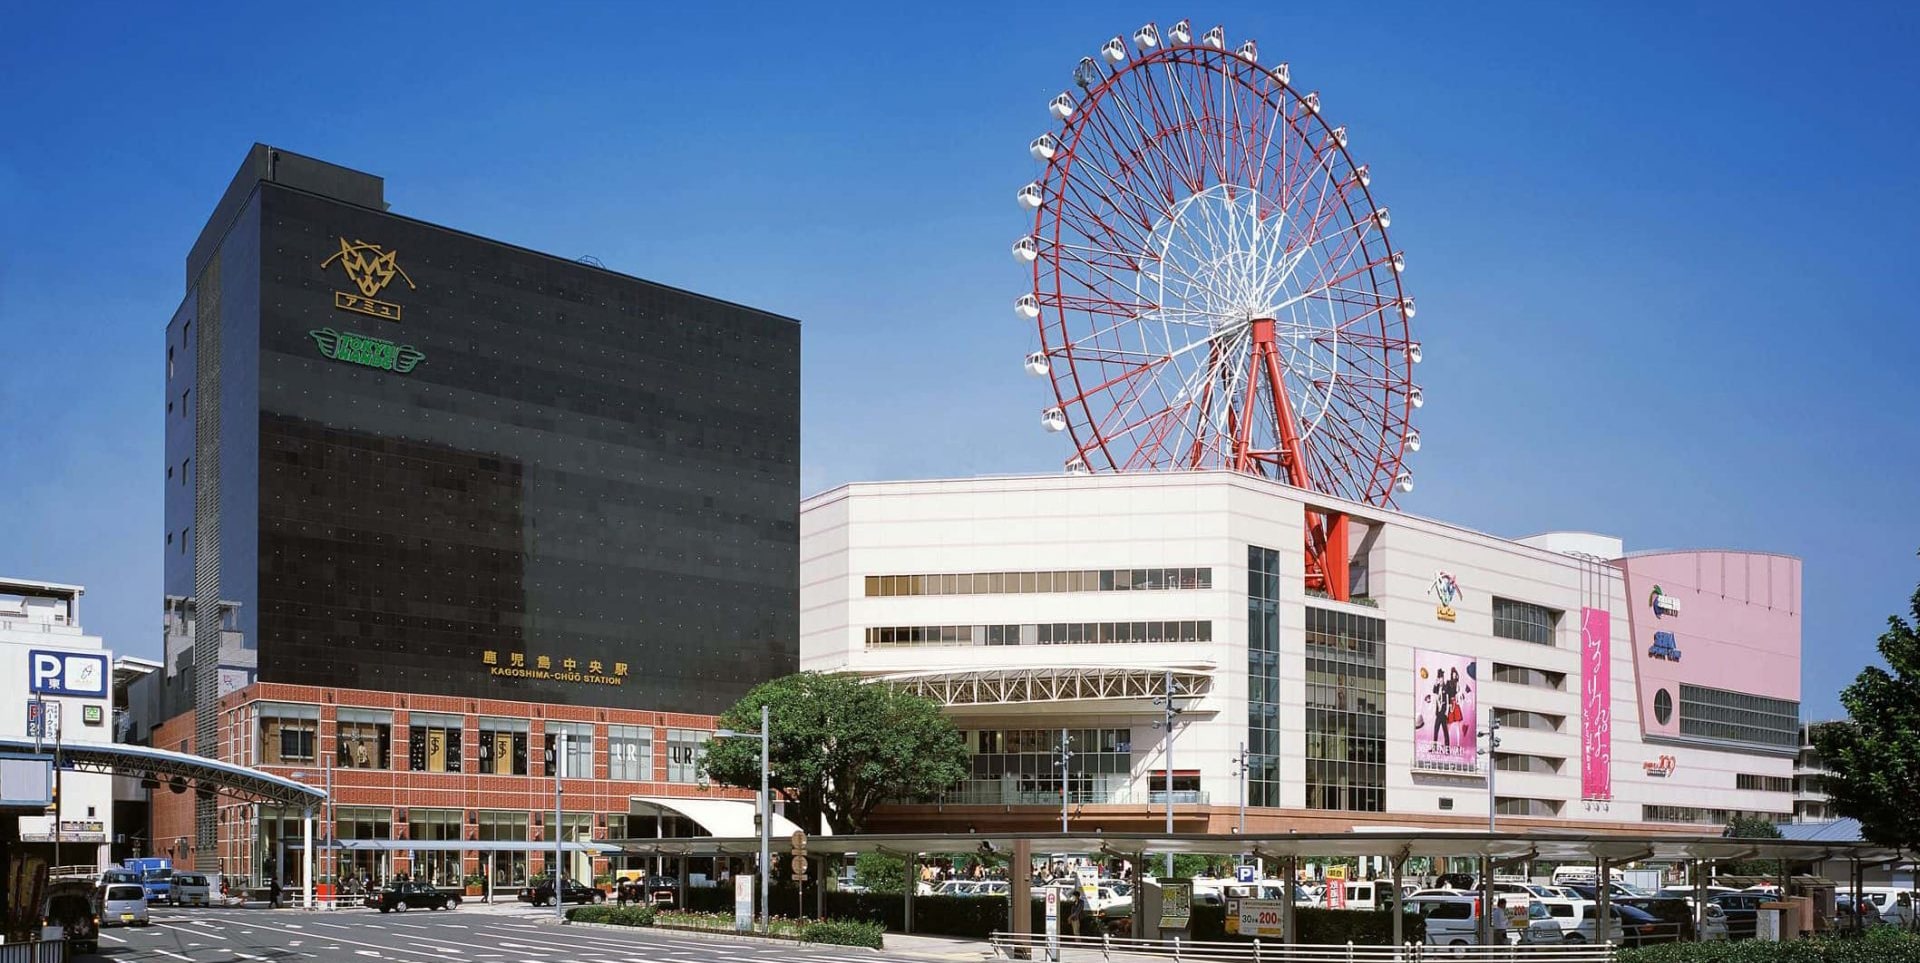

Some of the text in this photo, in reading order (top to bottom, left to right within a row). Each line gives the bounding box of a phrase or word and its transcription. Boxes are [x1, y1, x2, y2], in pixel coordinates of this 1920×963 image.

[344, 296, 392, 316] アミュ
[35, 654, 61, 688] P
[483, 650, 628, 676] 鹿児島中央駅
[48, 678, 61, 690] 東
[583, 675, 622, 686] STATION
[616, 743, 638, 762] UR
[673, 746, 692, 765] UR
[1239, 868, 1252, 881] P
